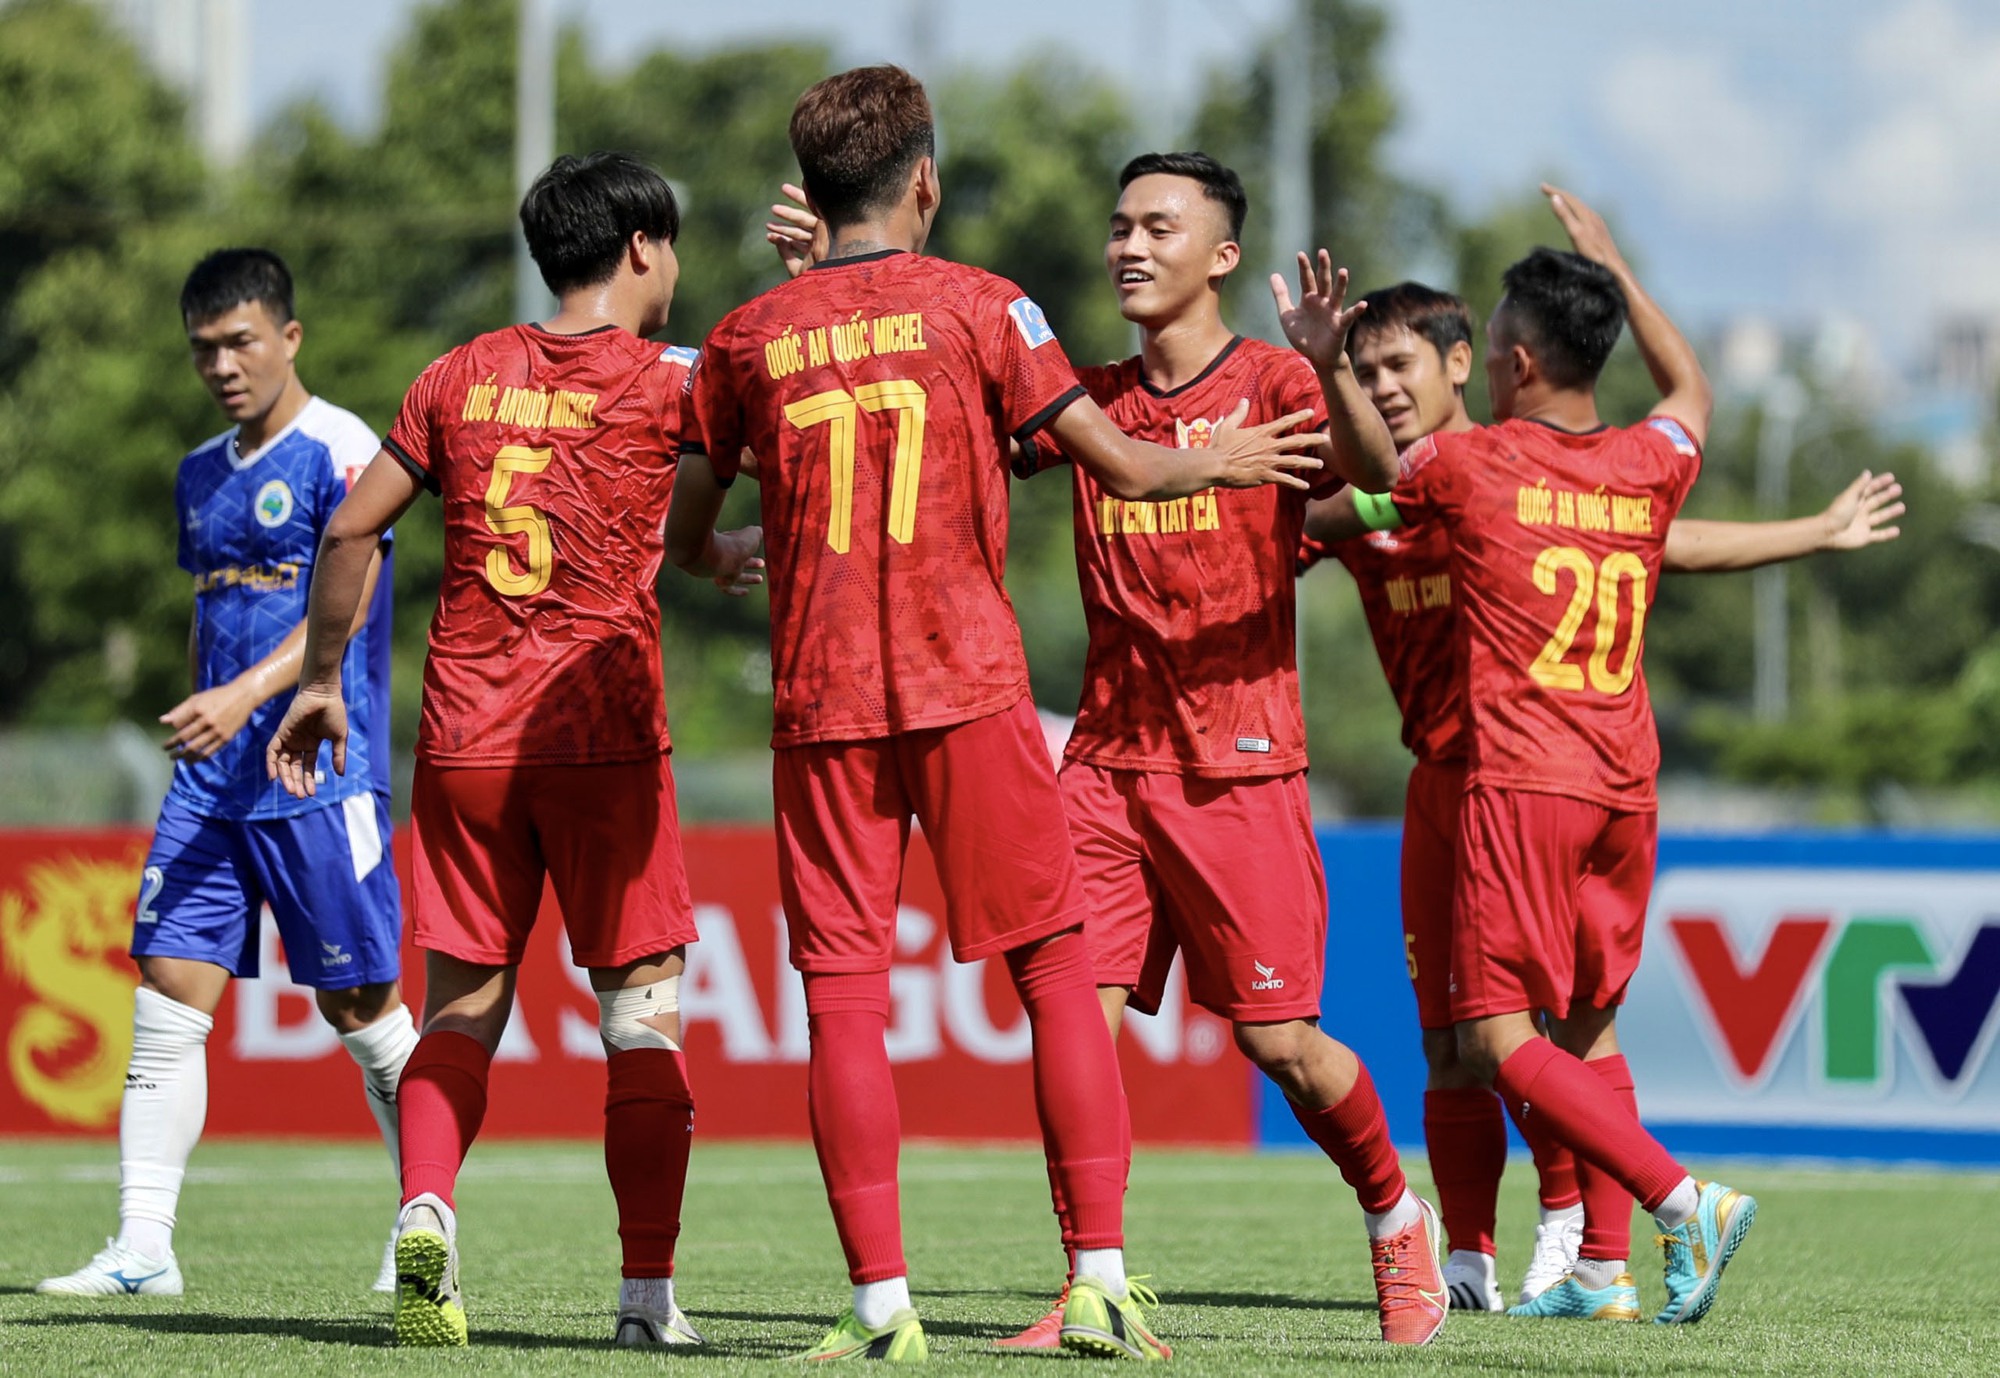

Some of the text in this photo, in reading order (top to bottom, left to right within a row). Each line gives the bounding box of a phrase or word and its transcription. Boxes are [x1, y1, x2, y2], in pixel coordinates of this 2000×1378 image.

[765, 310, 927, 380] QUỐC AN QUỐC MICHEL
[547, 390, 599, 429] MICHEL
[484, 445, 552, 597] 5
[783, 379, 927, 555] 77
[1517, 477, 1653, 535] QUỐC AN QUỐC MICHEL
[1528, 546, 1649, 695] 20
[1252, 979, 1284, 990] KAMITO
[1664, 916, 2000, 1084] VTV
